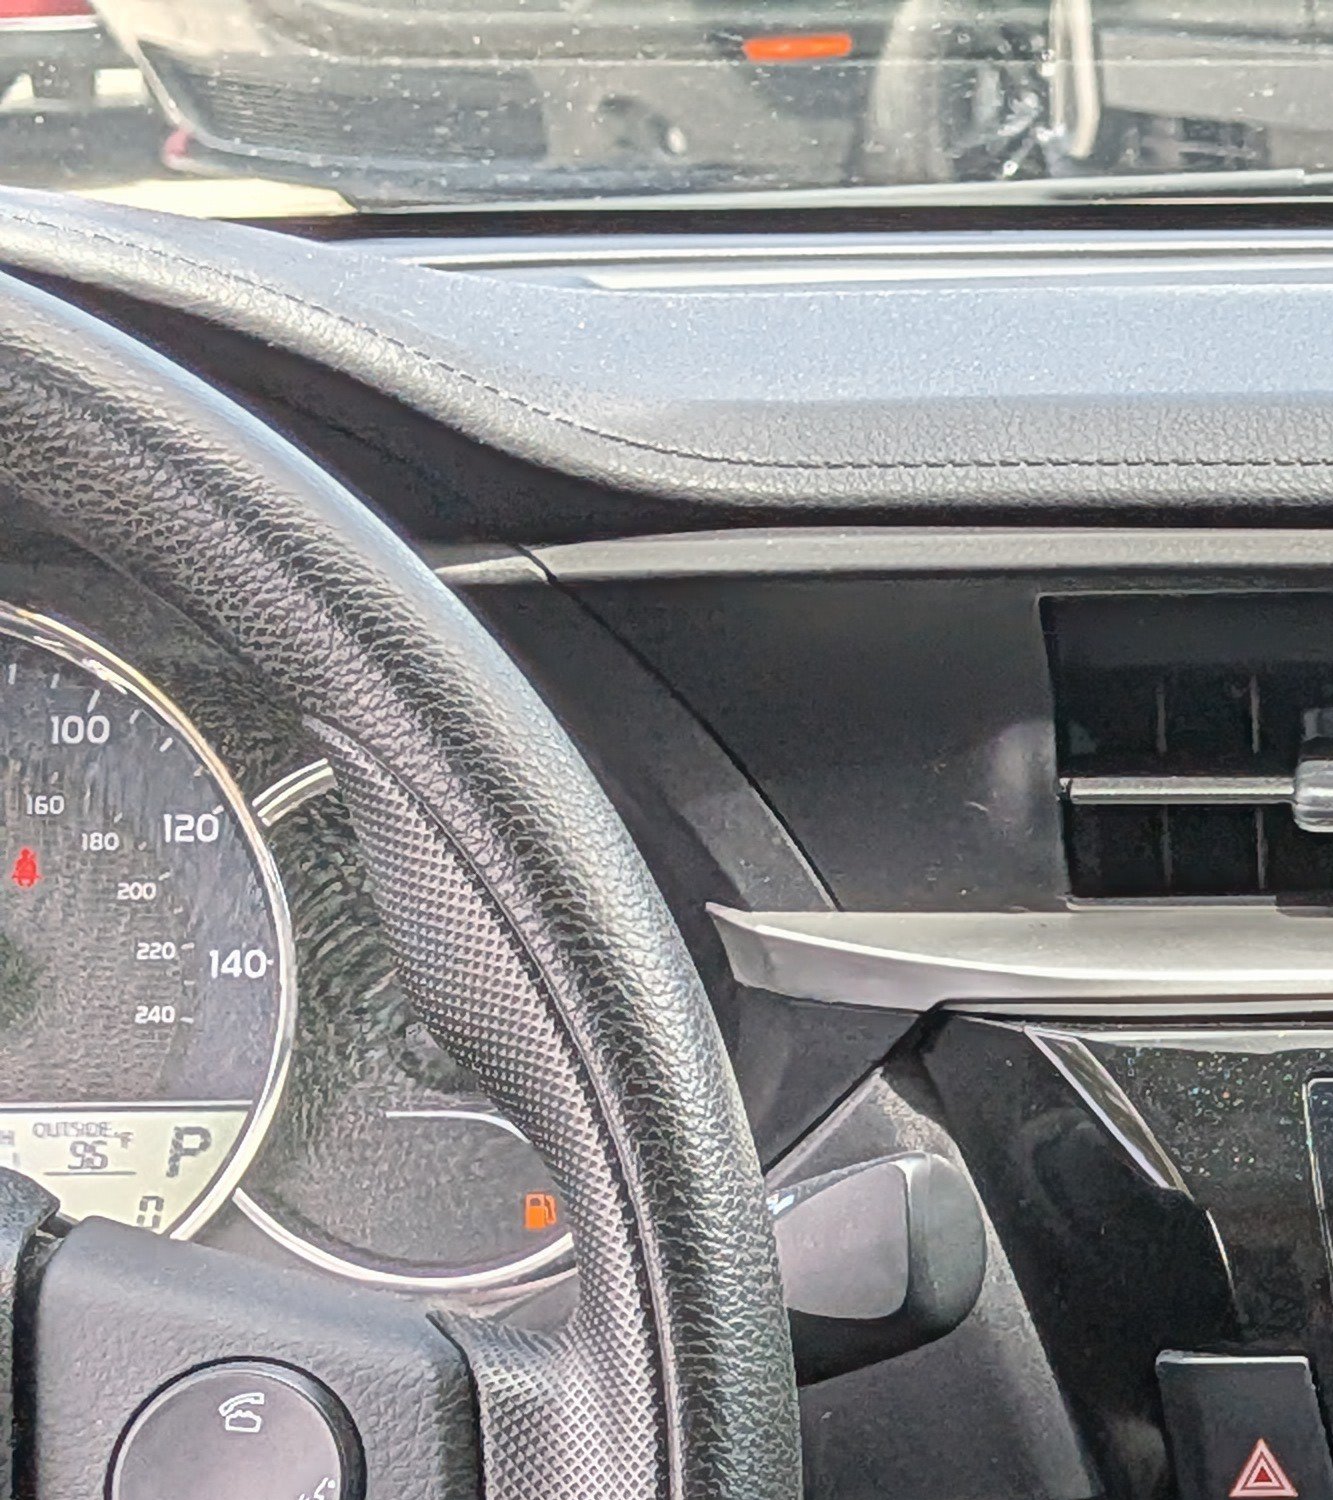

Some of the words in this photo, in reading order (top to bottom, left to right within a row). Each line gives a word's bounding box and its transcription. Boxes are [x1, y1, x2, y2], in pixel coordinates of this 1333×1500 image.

[50, 714, 111, 744] 100
[25, 795, 66, 816] 160
[163, 813, 219, 843] 120
[81, 832, 120, 851] 180
[116, 881, 157, 901] 200
[136, 941, 176, 961] 220
[209, 949, 267, 979] 140
[134, 1005, 176, 1025] 240
[166, 1125, 213, 1178] P
